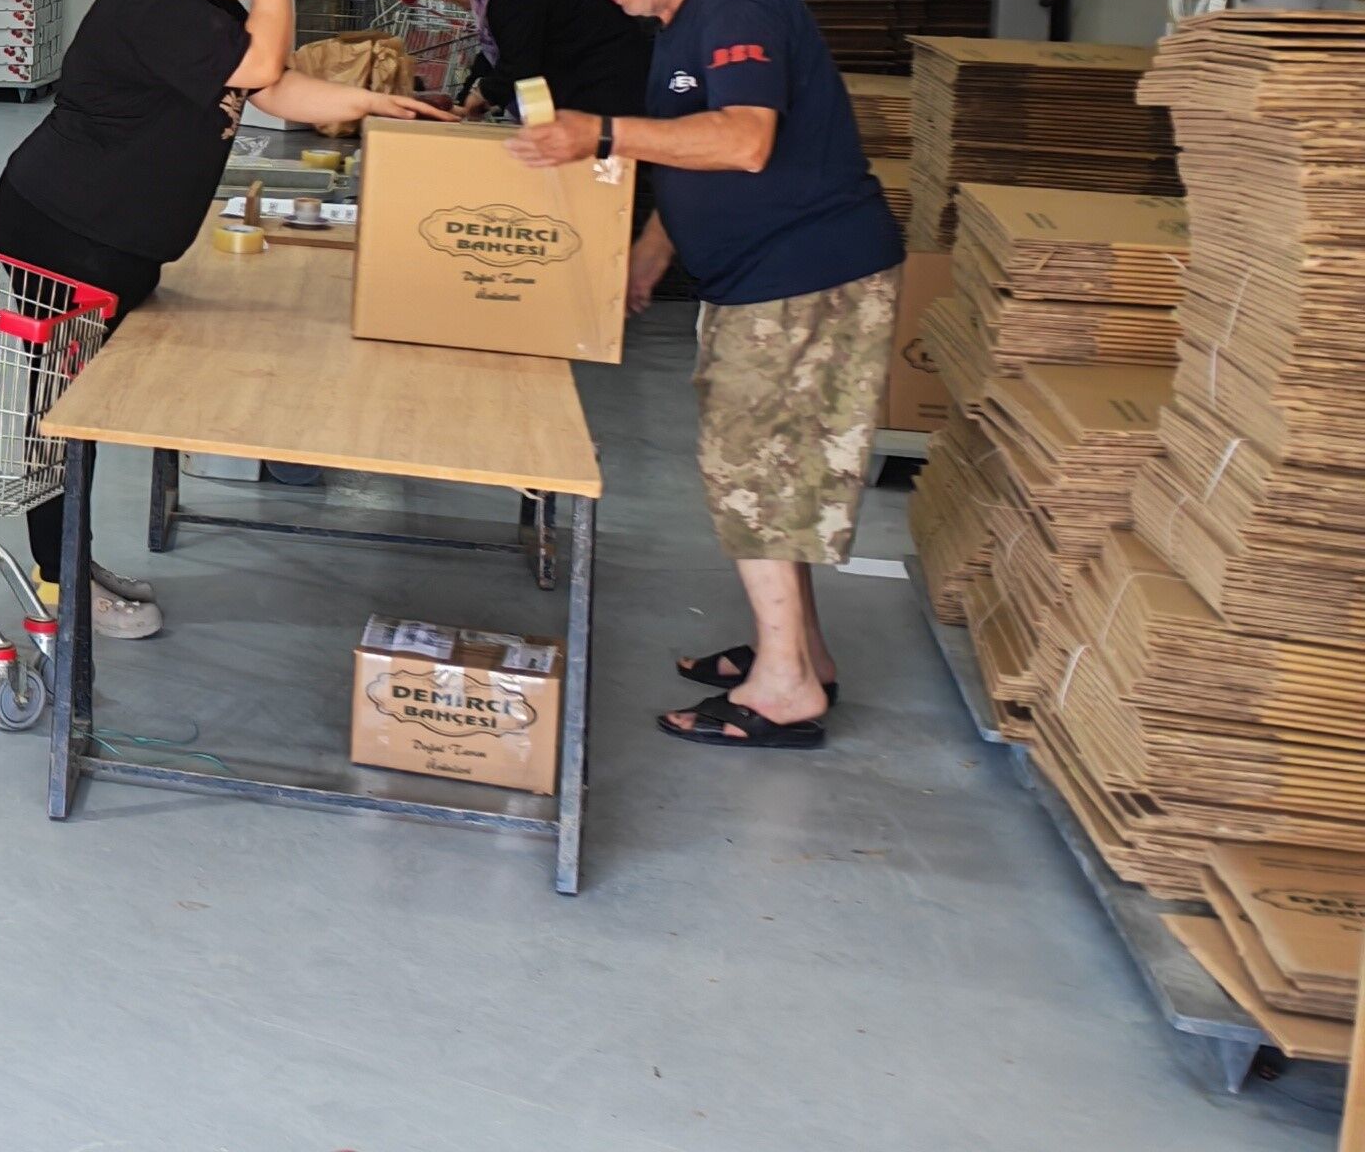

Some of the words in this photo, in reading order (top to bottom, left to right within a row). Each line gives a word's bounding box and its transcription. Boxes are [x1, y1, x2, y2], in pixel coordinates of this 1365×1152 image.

[445, 221, 559, 243] DEMİRCİ
[456, 239, 546, 257] BAHÇESİ
[403, 705, 498, 729] BAHÇESİ
